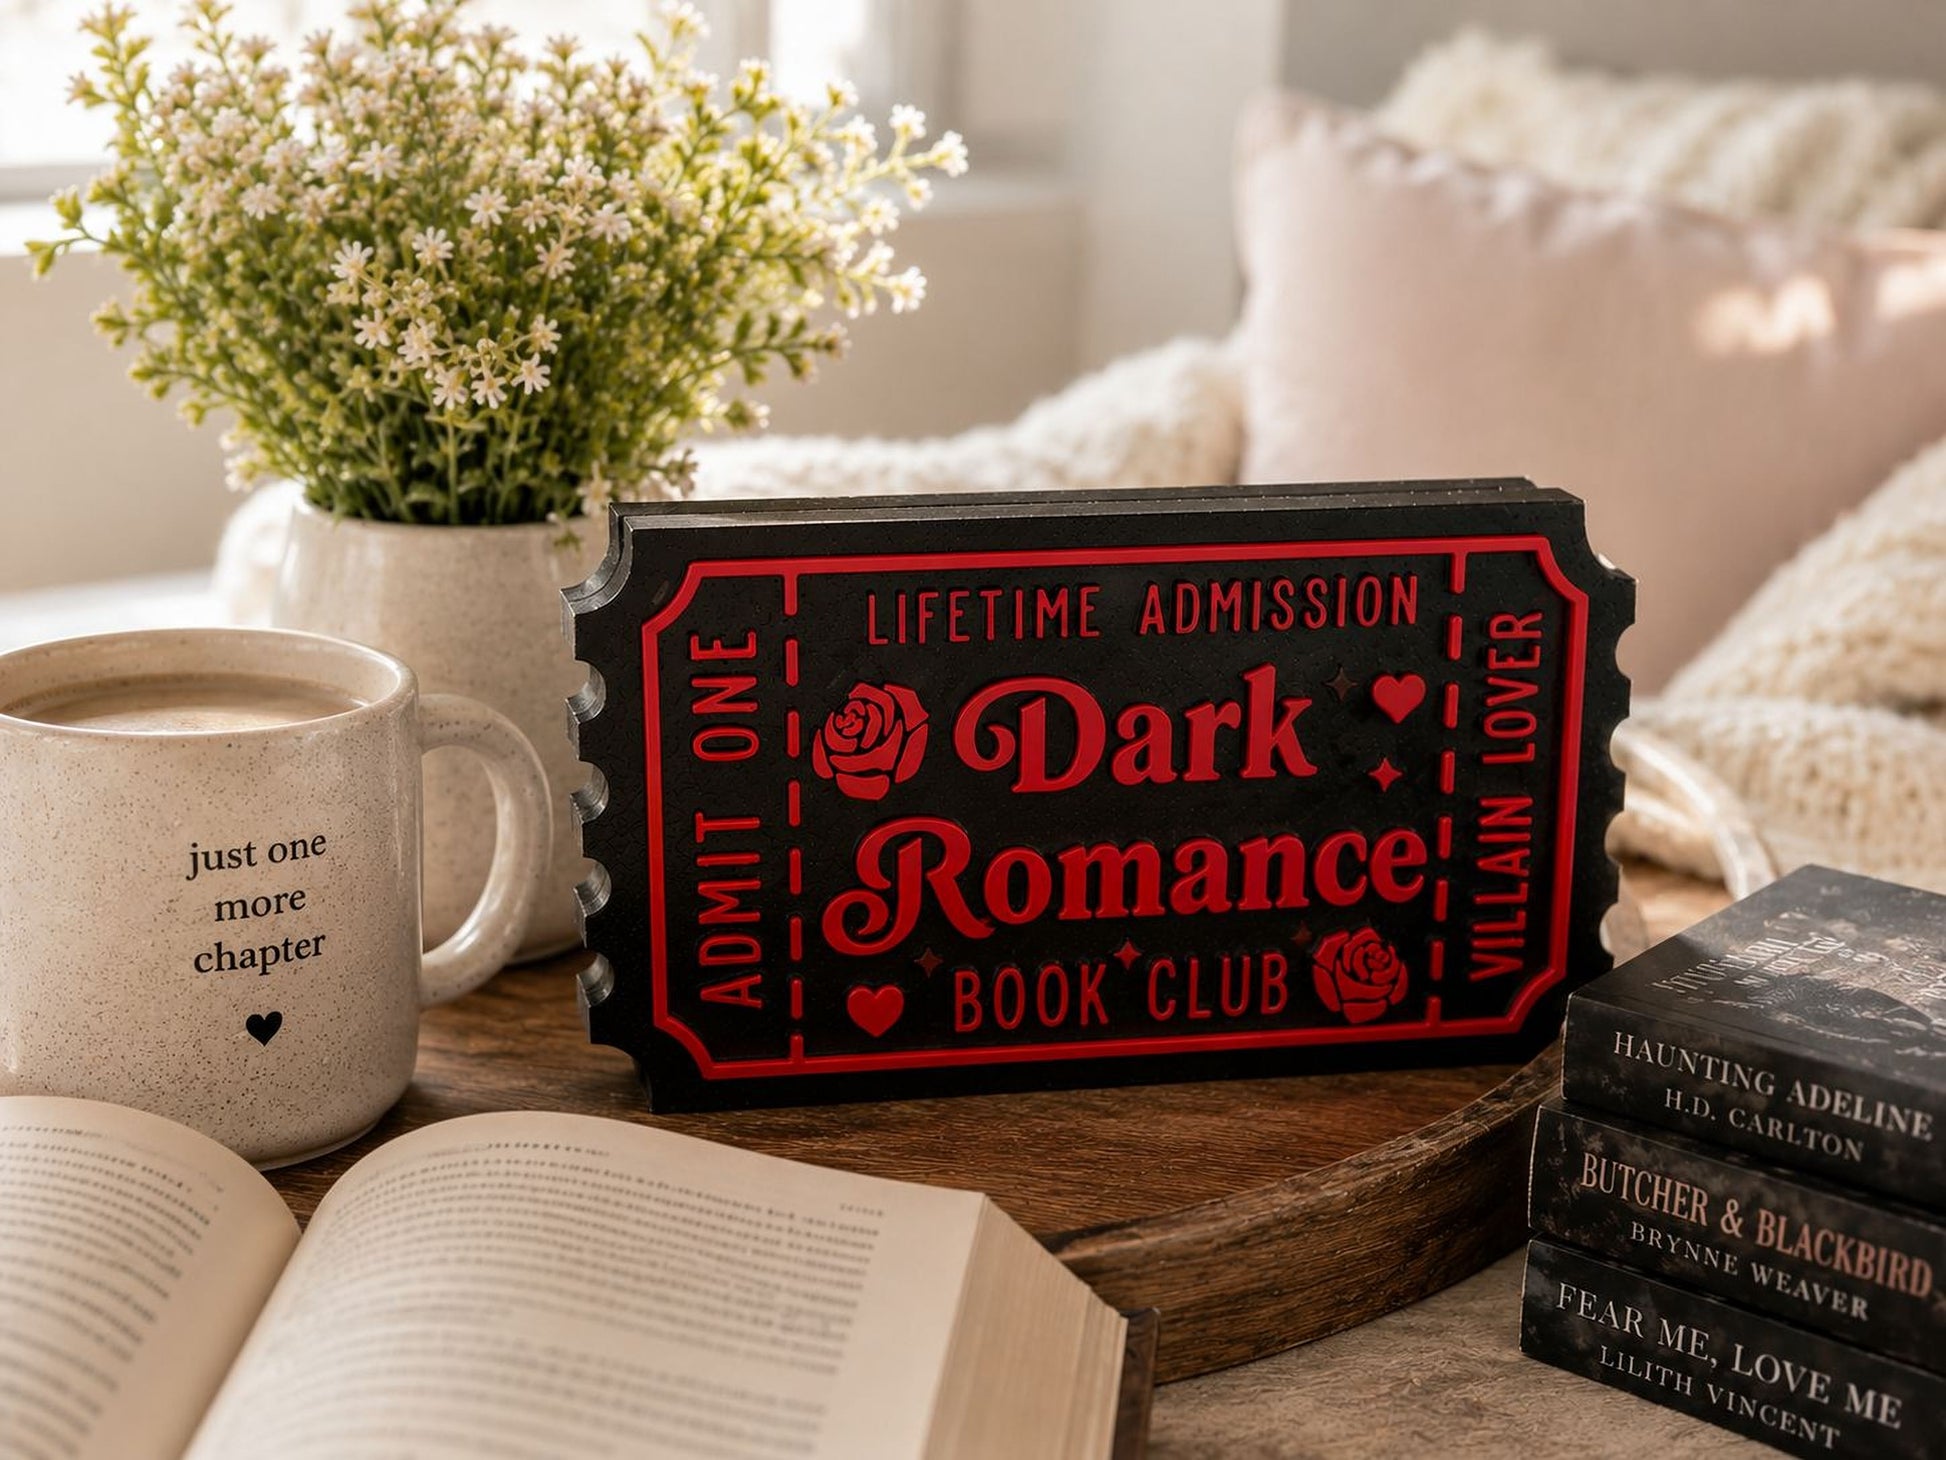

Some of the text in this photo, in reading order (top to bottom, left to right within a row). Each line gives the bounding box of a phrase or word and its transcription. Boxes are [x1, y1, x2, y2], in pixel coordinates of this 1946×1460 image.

[866, 573, 1419, 647] LIFETIME ADMISSION
[951, 660, 1320, 795] Dark
[687, 628, 765, 1010] ADMIT ONE
[1467, 610, 1545, 983] VILLAIN LOVER
[187, 833, 327, 881] just one
[214, 890, 306, 922] more
[819, 814, 1430, 958] Romance
[193, 931, 326, 976] chapter
[953, 949, 1290, 1034] BOOK CLUB
[1613, 1031, 1934, 1142] HAUNTING ADELINE
[1664, 1088, 1865, 1162] H.D. CARLTON
[1580, 1152, 1934, 1299] BUTCHER & BLACKBIRD
[1630, 1222, 1869, 1321] BRYNNE WEAVER
[1556, 1282, 1904, 1430] FEAR ME, LOVE ME
[1599, 1345, 1841, 1450] LILITH VINCENT
